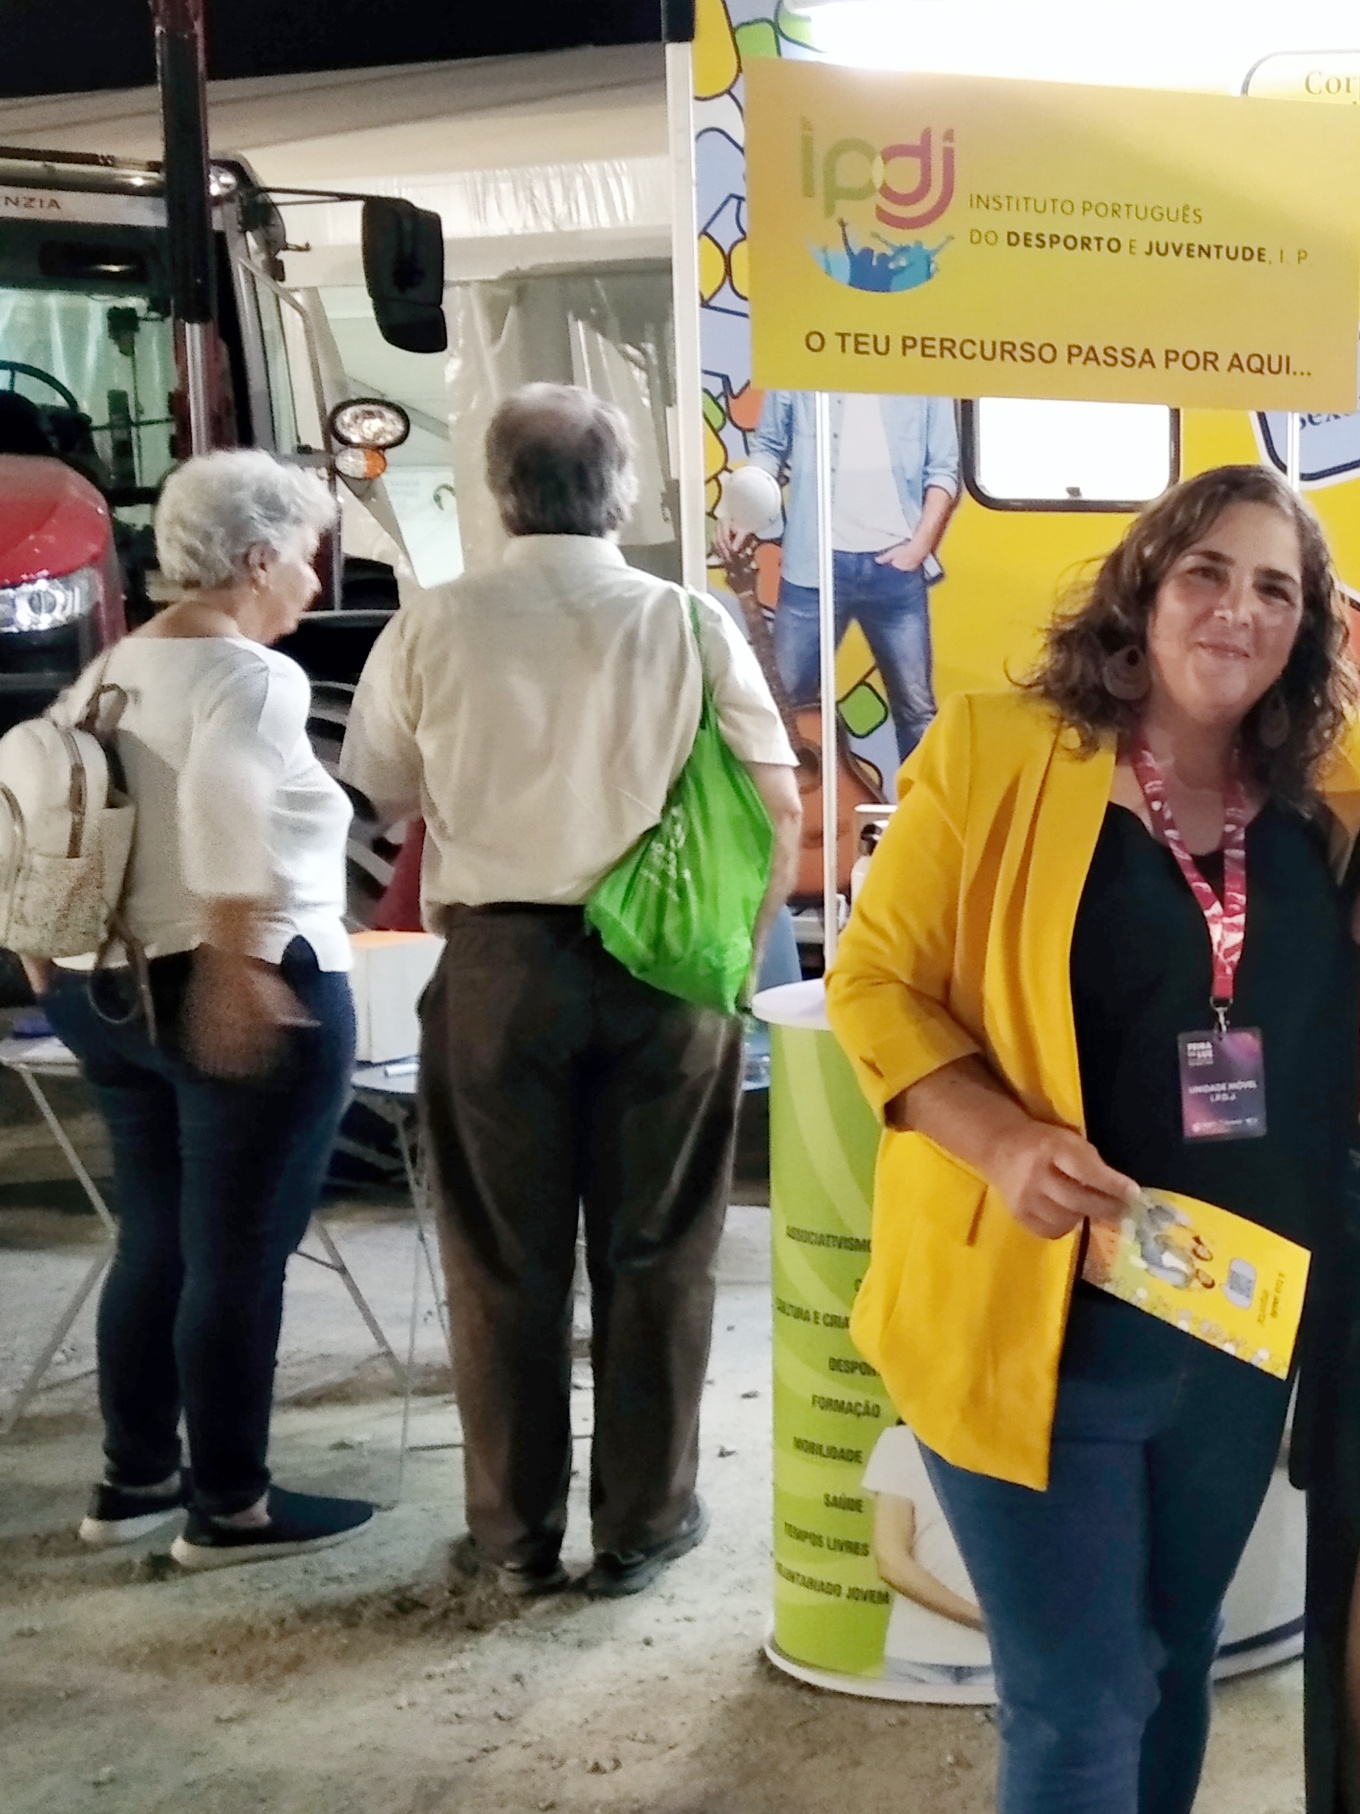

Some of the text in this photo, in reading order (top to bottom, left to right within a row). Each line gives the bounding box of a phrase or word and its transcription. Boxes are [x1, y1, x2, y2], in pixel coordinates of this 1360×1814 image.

[801, 115, 955, 230] ipdj
[969, 193, 1203, 225] INSTITUTO PORTUGUÊS
[969, 228, 999, 246] DO
[1006, 230, 1122, 254] DESPORTO
[1129, 239, 1138, 255] E
[805, 330, 1312, 377] O TEU PERCURSO PASSA POR AQUI...
[811, 1394, 881, 1420] FORMAÇÃO
[792, 1436, 864, 1464] MOBILIDADE
